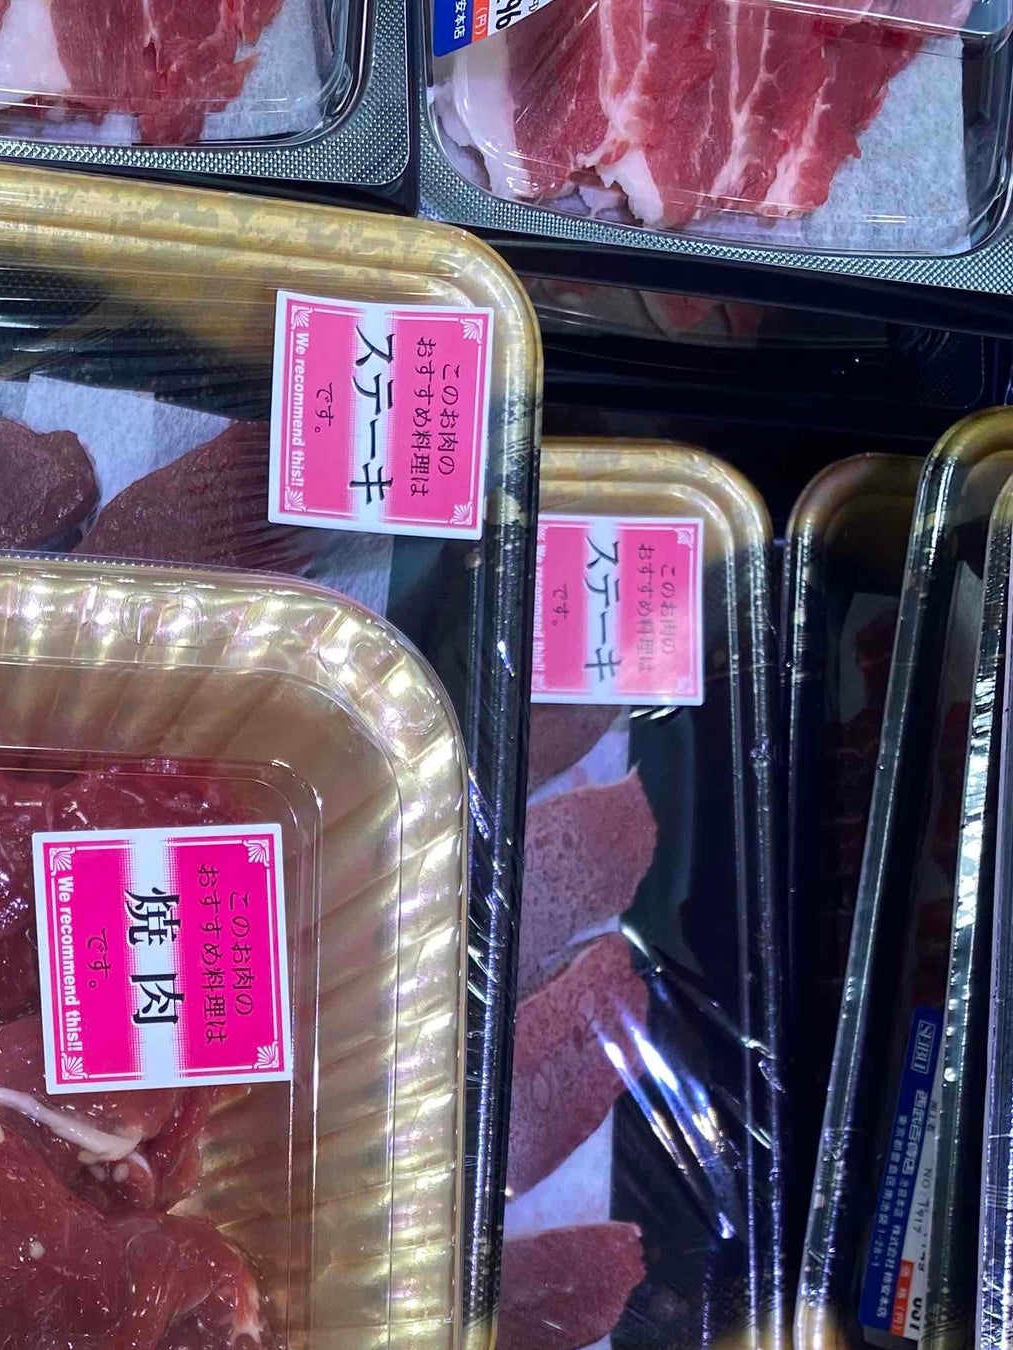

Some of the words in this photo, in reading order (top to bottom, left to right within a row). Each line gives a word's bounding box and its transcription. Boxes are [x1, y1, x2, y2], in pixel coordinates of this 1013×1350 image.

[295, 332, 309, 356] We
[292, 358, 309, 447] recommend
[315, 382, 334, 433] です。
[349, 325, 395, 505] ステーキ
[411, 336, 436, 497] おすすめ料理は
[438, 364, 460, 475] このお肉の
[291, 450, 304, 487] this!!
[584, 536, 622, 683] ステーキ
[58, 876, 74, 903] We
[60, 907, 81, 1006] recommend
[88, 927, 110, 989] です。
[125, 887, 185, 1024] 焼肉
[198, 863, 227, 1044] おすすめ料理は
[230, 891, 255, 1016] このお肉の
[66, 1009, 83, 1052] this!!
[914, 1023, 932, 1071] SEIBU
